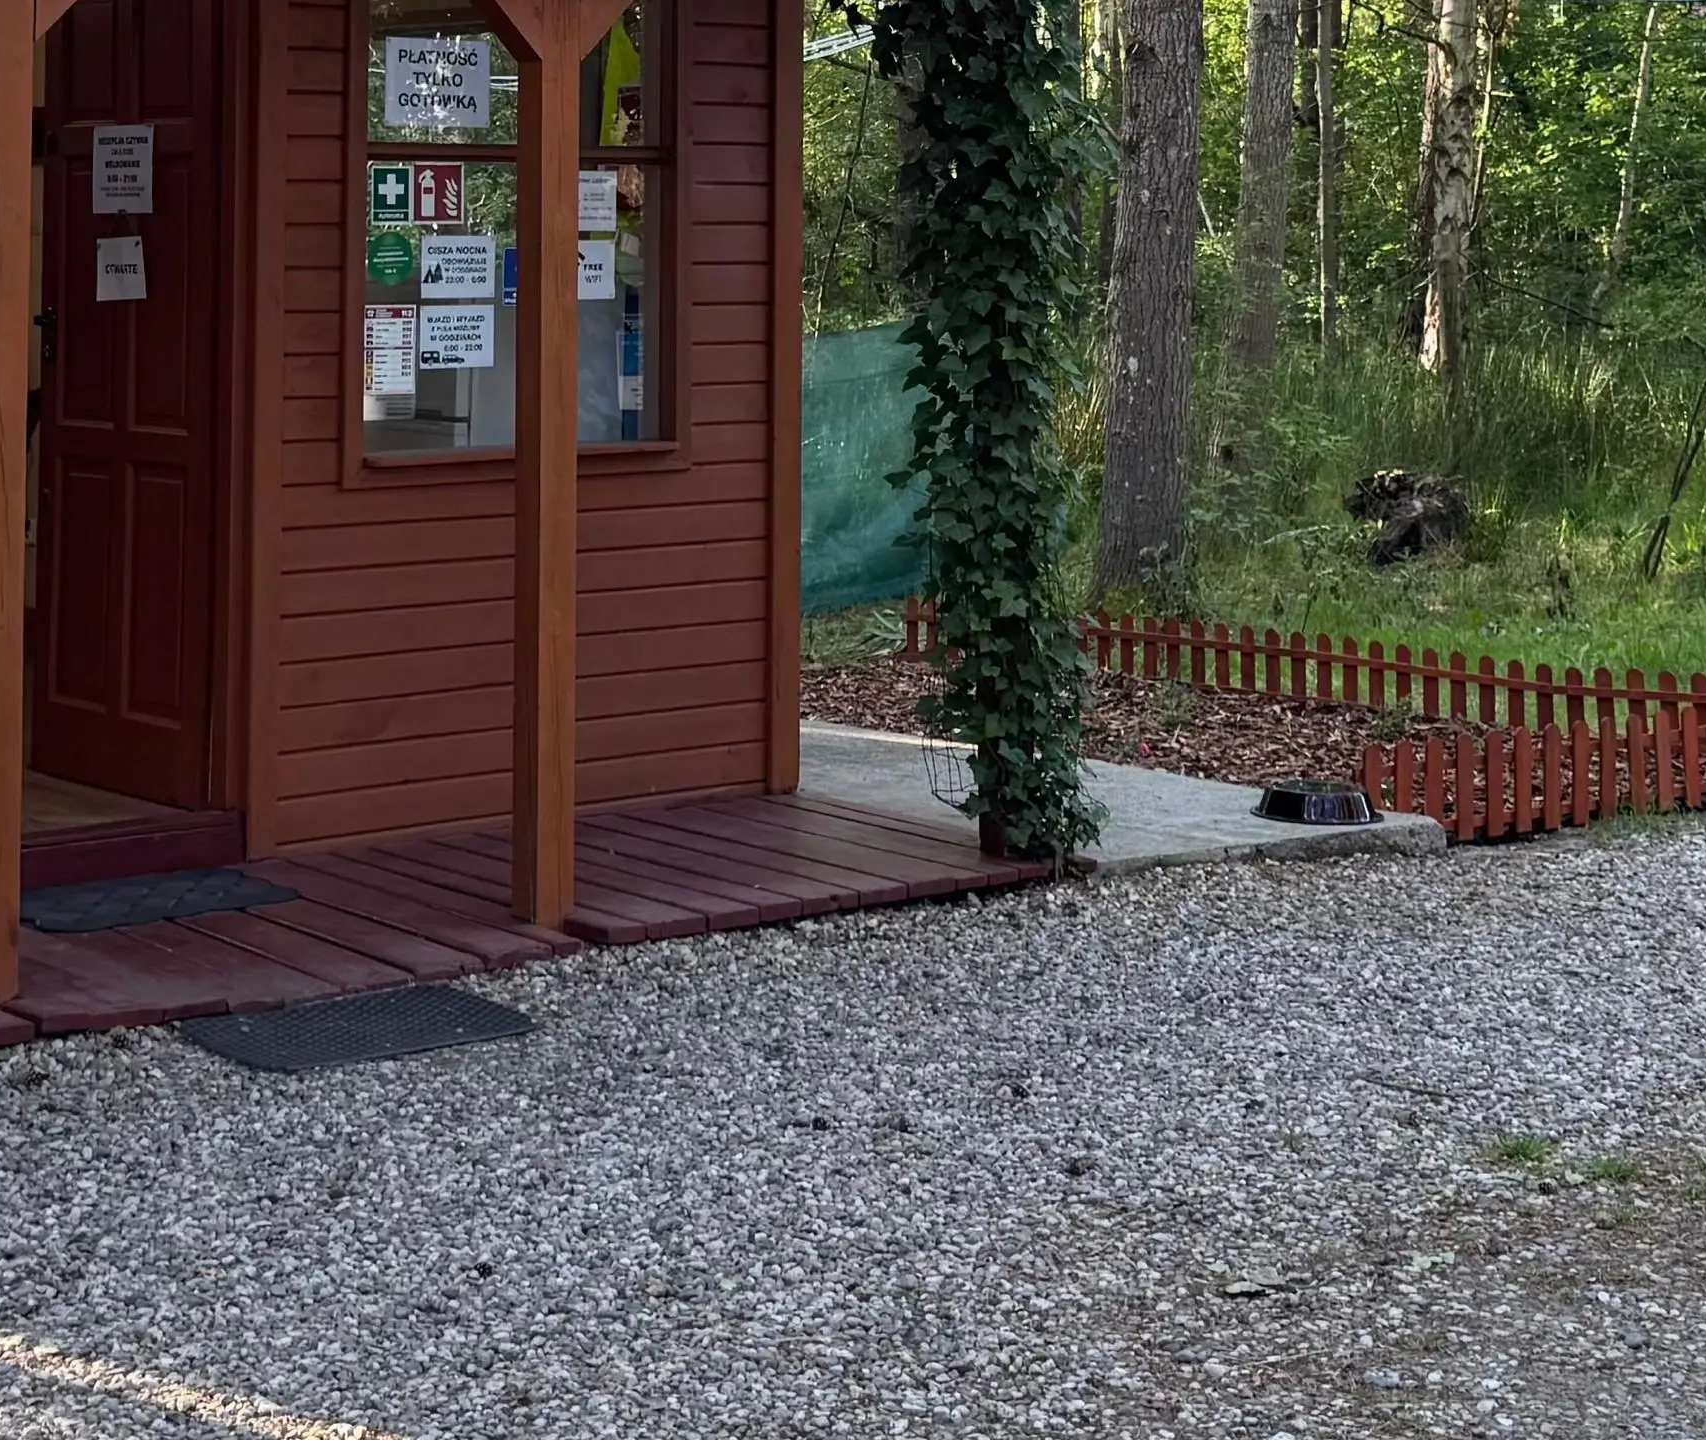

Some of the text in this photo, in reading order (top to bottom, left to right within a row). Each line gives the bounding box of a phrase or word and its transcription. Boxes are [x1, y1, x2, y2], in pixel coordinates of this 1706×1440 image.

[398, 47, 478, 67] PŁATNOŚĆ
[412, 72, 463, 87] TYLKO
[398, 90, 477, 113] GOTÓWKĄ
[427, 246, 488, 255] CISZA NOCNA
[583, 263, 604, 272] FREE
